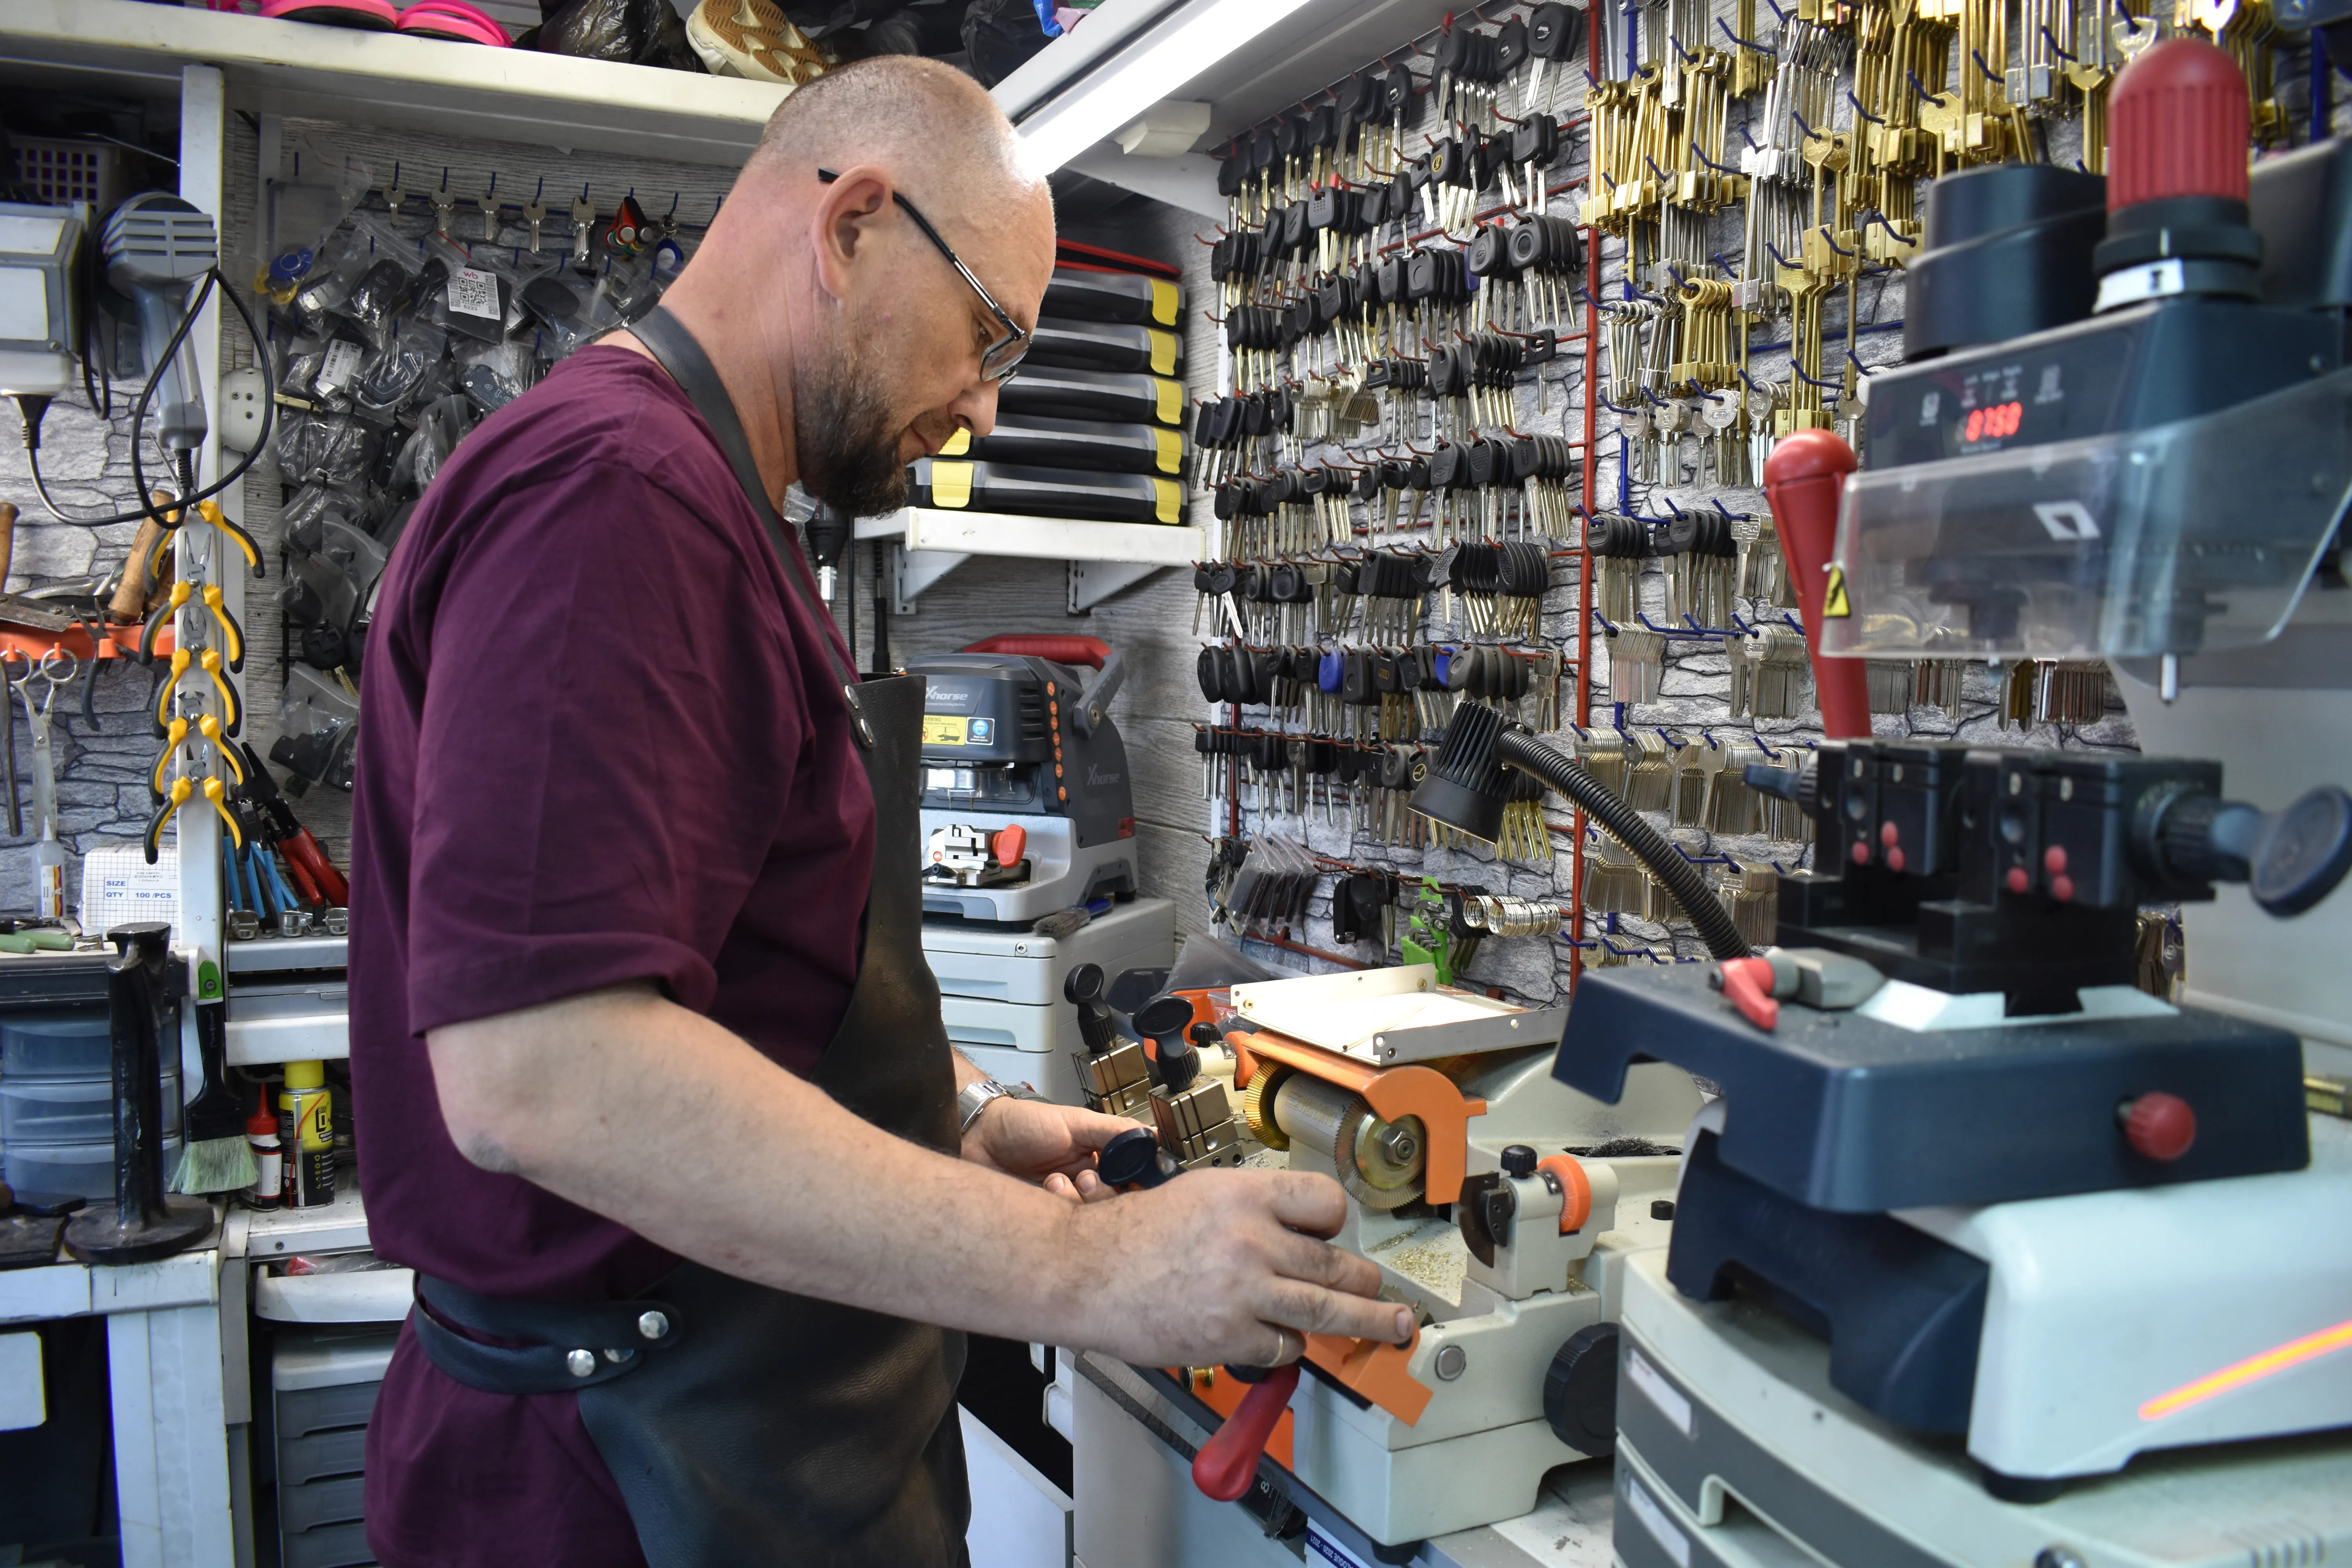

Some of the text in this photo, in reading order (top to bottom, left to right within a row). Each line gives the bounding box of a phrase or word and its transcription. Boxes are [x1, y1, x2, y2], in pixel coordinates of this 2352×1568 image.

[463, 271, 478, 279] wb
[926, 686, 968, 701] Xhorse
[1087, 763, 1120, 786] Xhorse
[1310, 1534, 1321, 1548] 2021
[1323, 1544, 1334, 1558] 2020
